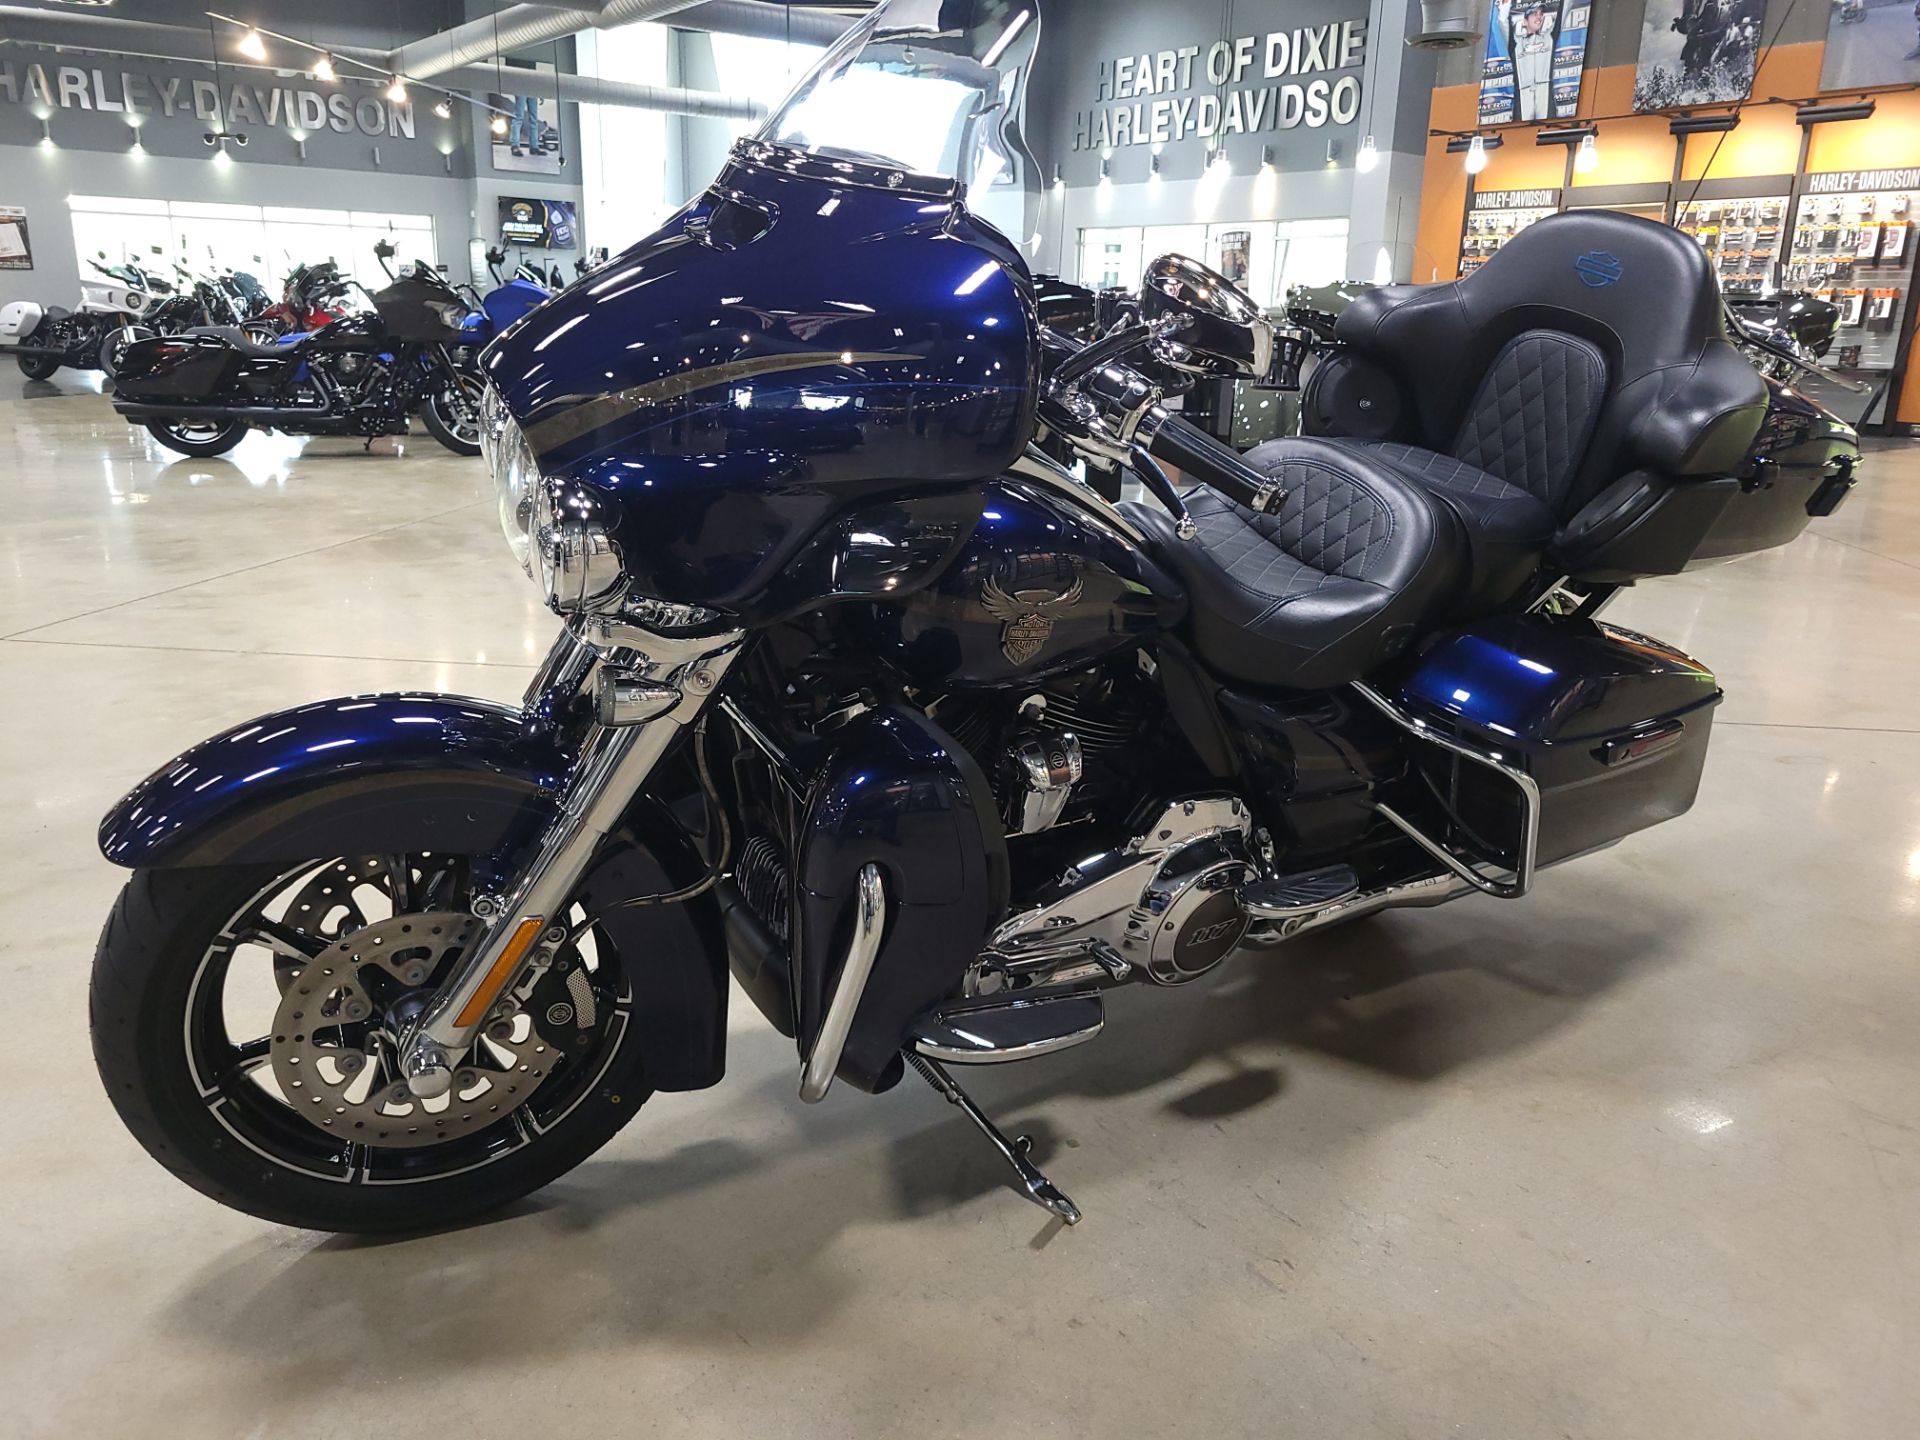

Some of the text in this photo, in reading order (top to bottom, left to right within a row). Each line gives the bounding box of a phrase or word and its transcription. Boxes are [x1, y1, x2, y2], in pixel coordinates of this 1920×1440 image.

[1096, 18, 1367, 101] HEART OF DIXIE
[1809, 168, 1920, 193] HARLEY-DAVIDSON
[1475, 189, 1553, 209] HARLEY-DAVIDSON
[1186, 917, 1238, 947] 117
